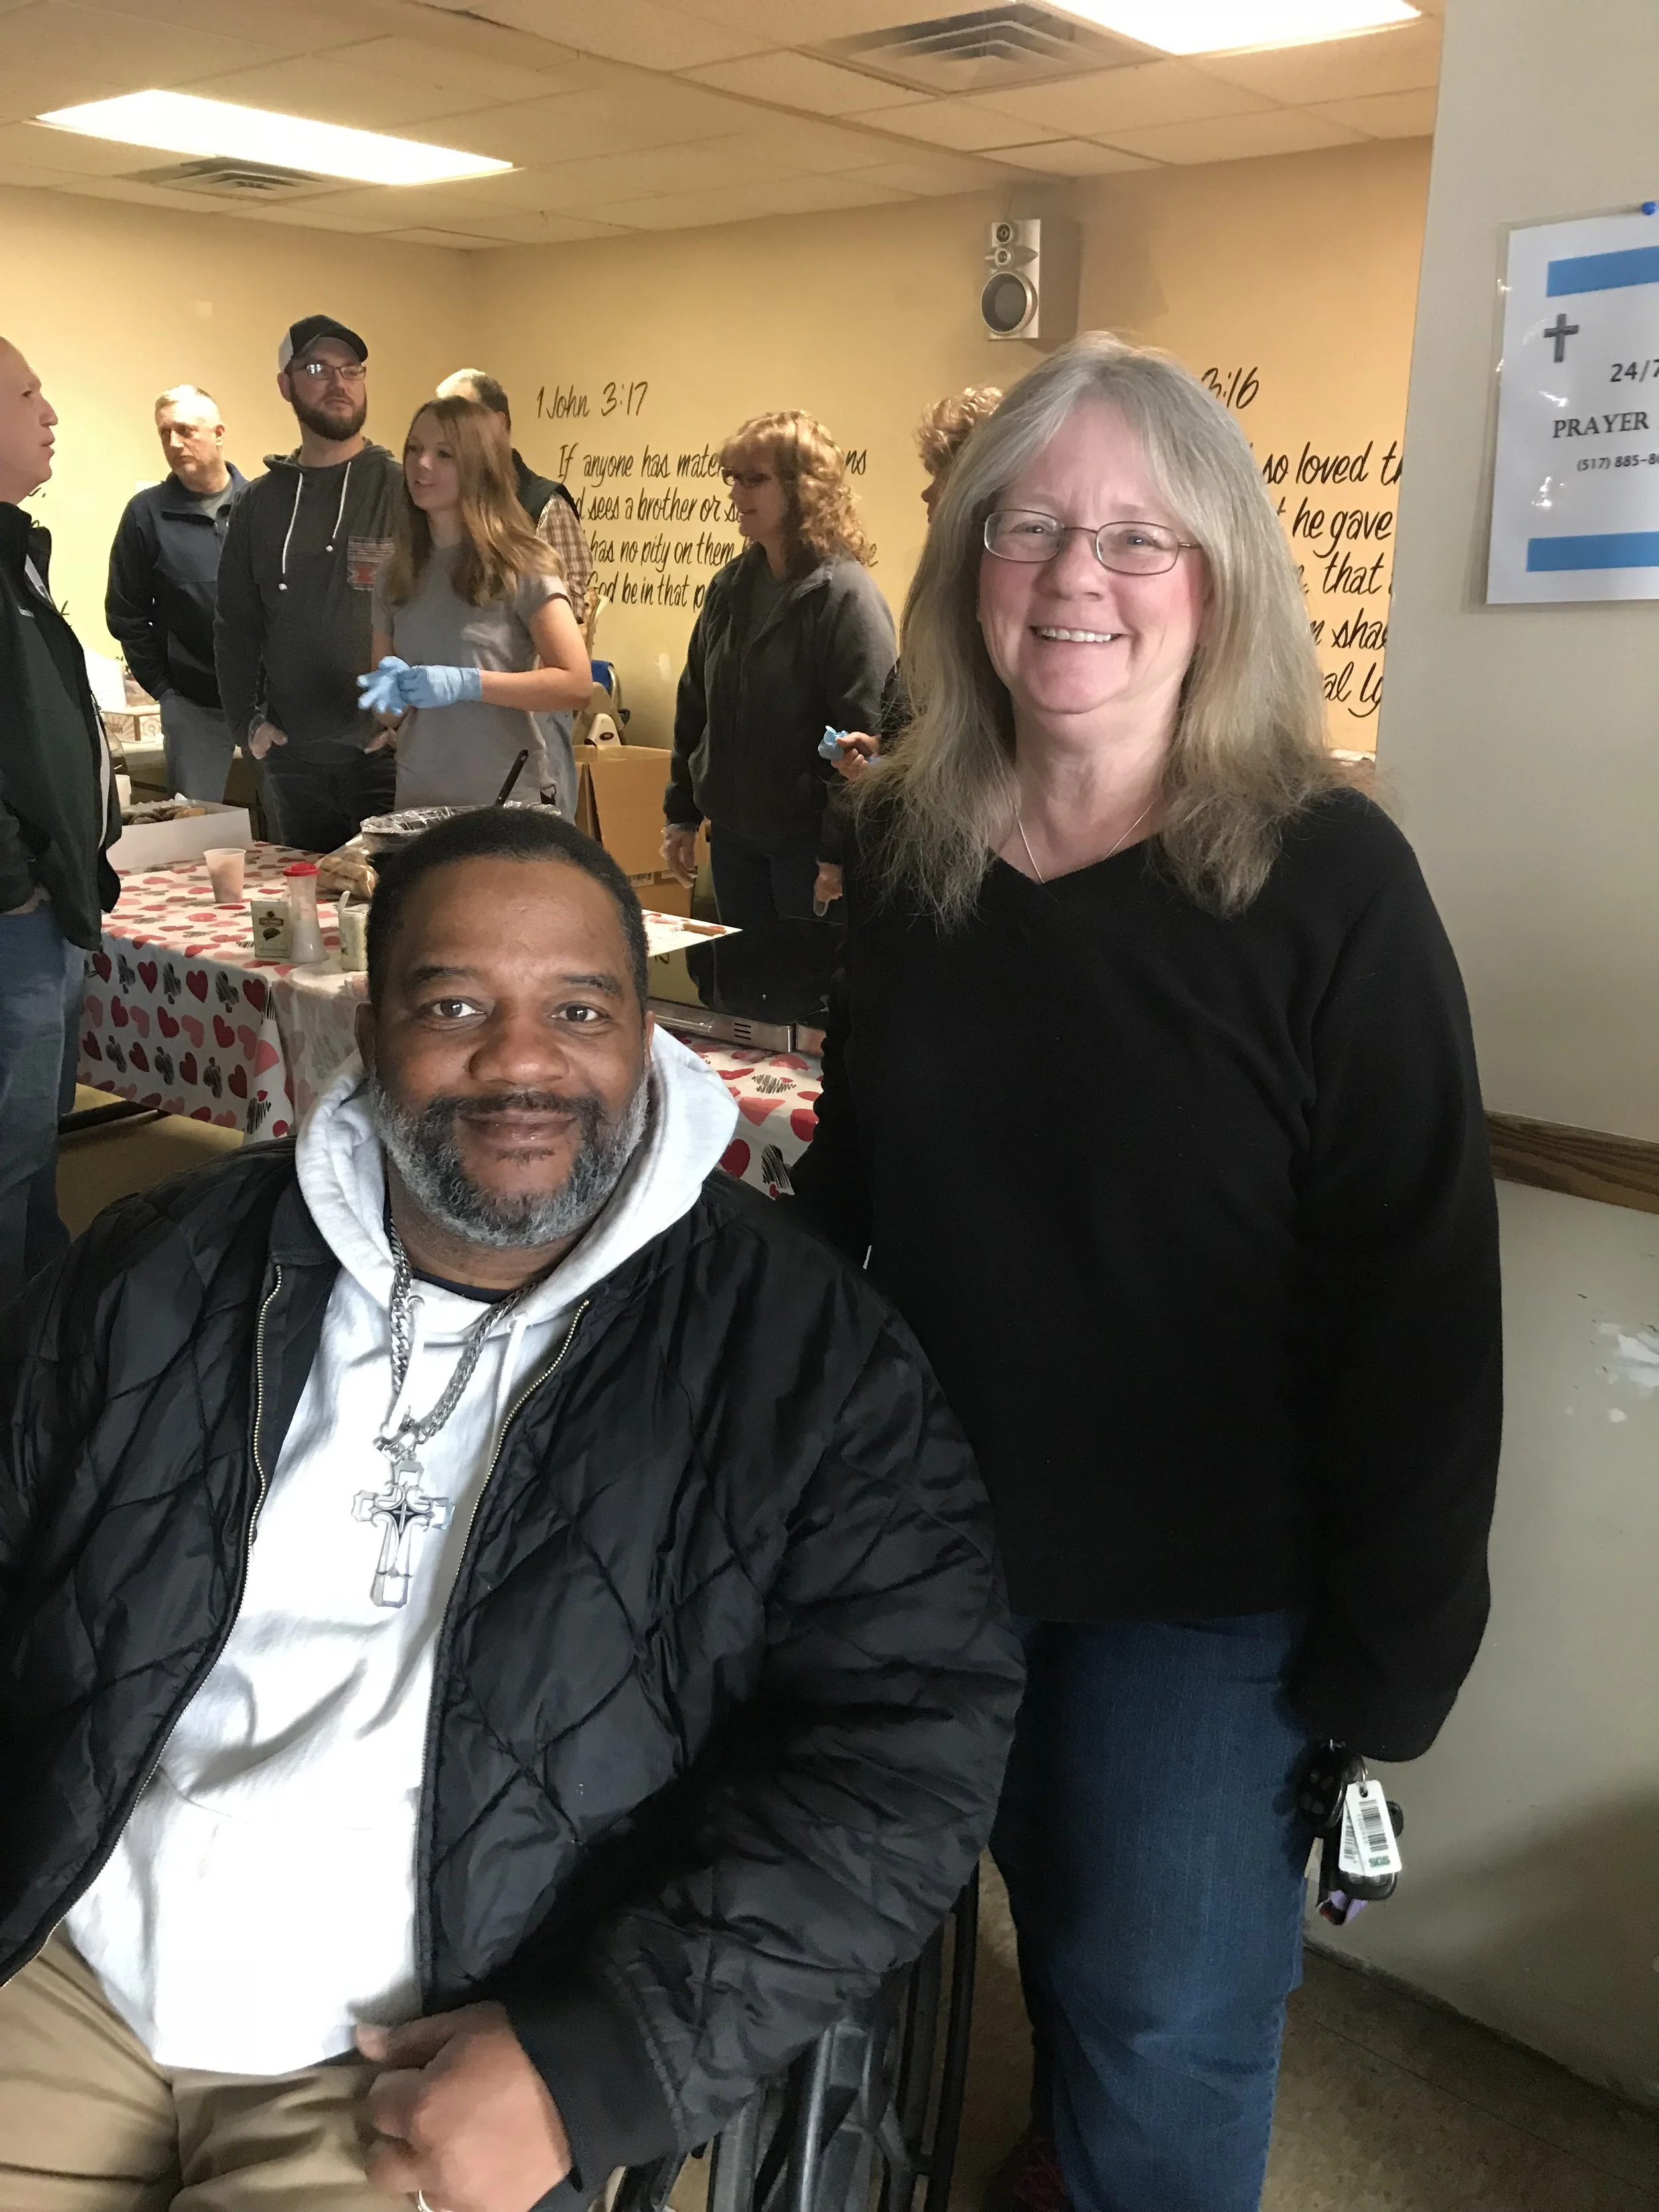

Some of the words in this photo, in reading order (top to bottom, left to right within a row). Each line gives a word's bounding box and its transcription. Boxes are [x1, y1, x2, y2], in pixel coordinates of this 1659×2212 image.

[536, 386, 545, 419] 1
[546, 384, 591, 419] John
[601, 381, 648, 417] 3:17
[1552, 411, 1649, 438] PRAYER
[558, 442, 579, 484] If
[583, 453, 634, 488] anyone
[641, 444, 671, 478] has
[1295, 440, 1374, 484] loved
[1576, 457, 1611, 473] (517)
[587, 495, 620, 521] sees
[625, 496, 634, 520] a
[638, 486, 699, 522] brother
[699, 494, 722, 522] or
[1292, 496, 1325, 539] he
[1313, 509, 1394, 558] gave
[590, 530, 615, 563] has
[620, 540, 639, 563] no
[640, 532, 672, 573] pity
[674, 541, 692, 564] on
[696, 532, 735, 566] them
[622, 572, 638, 605] be
[640, 576, 654, 605] in
[657, 573, 690, 607] that
[1323, 551, 1385, 595] that
